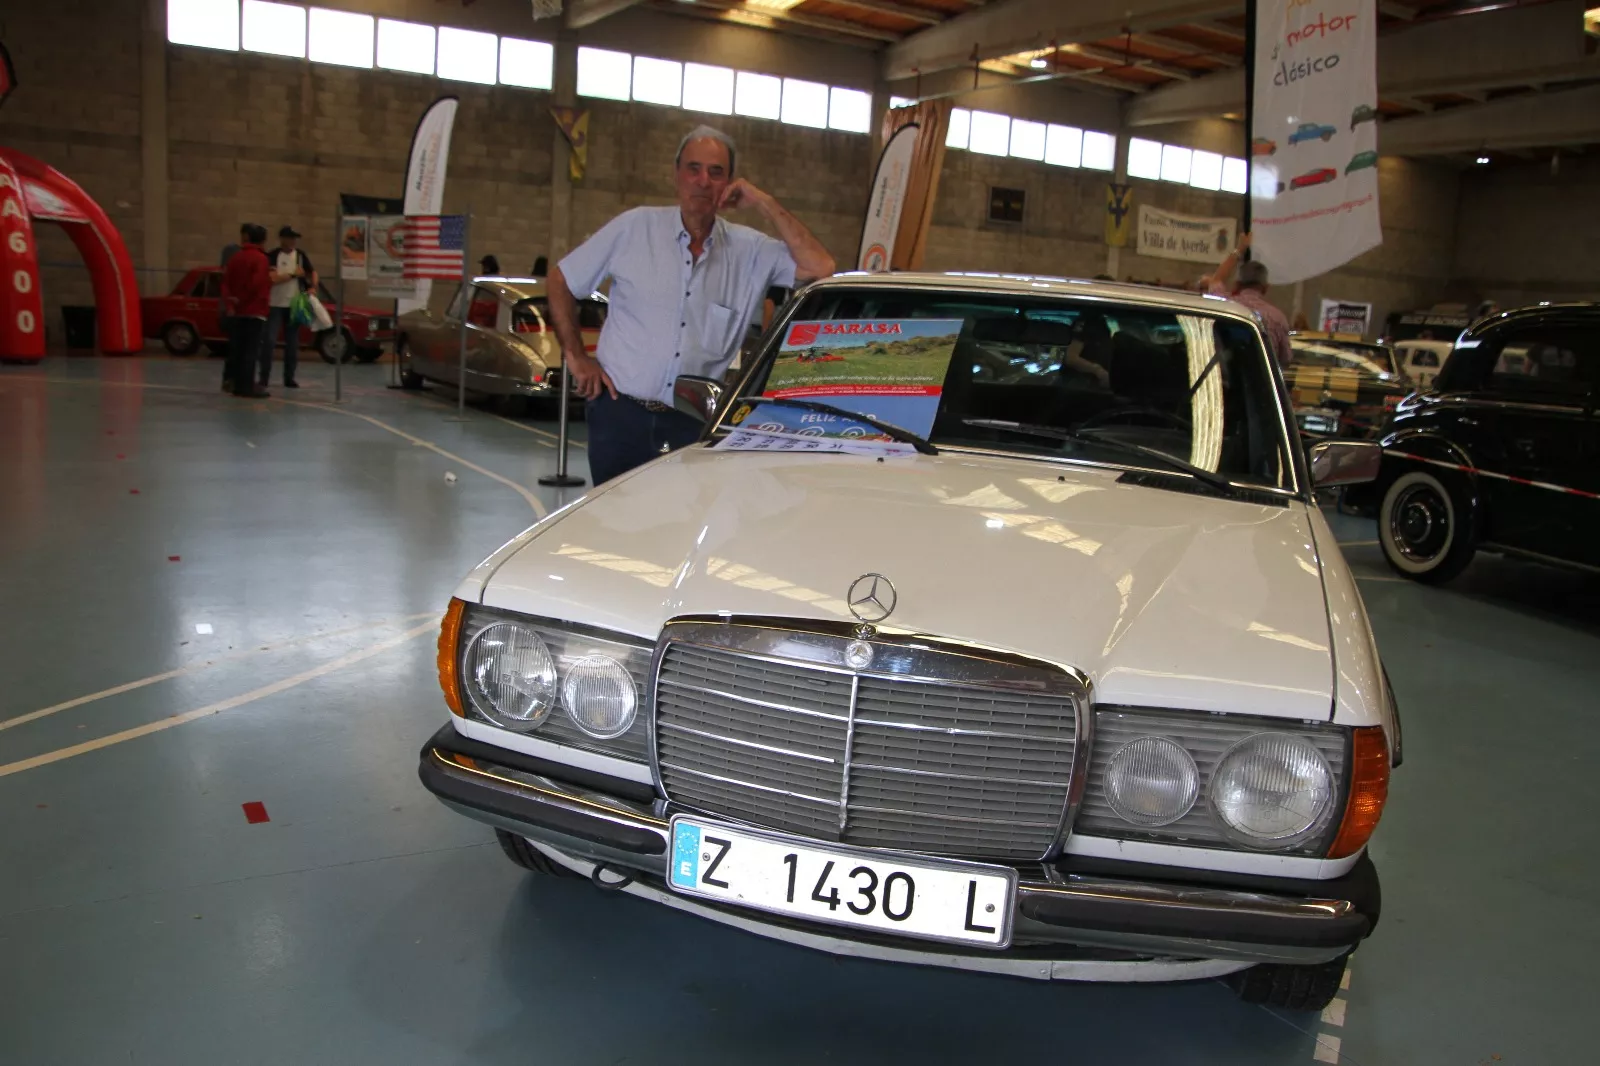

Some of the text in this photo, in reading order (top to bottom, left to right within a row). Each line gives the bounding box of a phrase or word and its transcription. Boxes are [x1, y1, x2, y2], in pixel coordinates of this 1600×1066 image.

[1286, 12, 1357, 47] motor
[1273, 54, 1341, 87] clásico
[1143, 230, 1165, 248] Villa
[823, 323, 903, 335] SARASA
[800, 414, 836, 424] FELIZ
[680, 862, 692, 877] E
[701, 835, 996, 934] Z 1430 L
